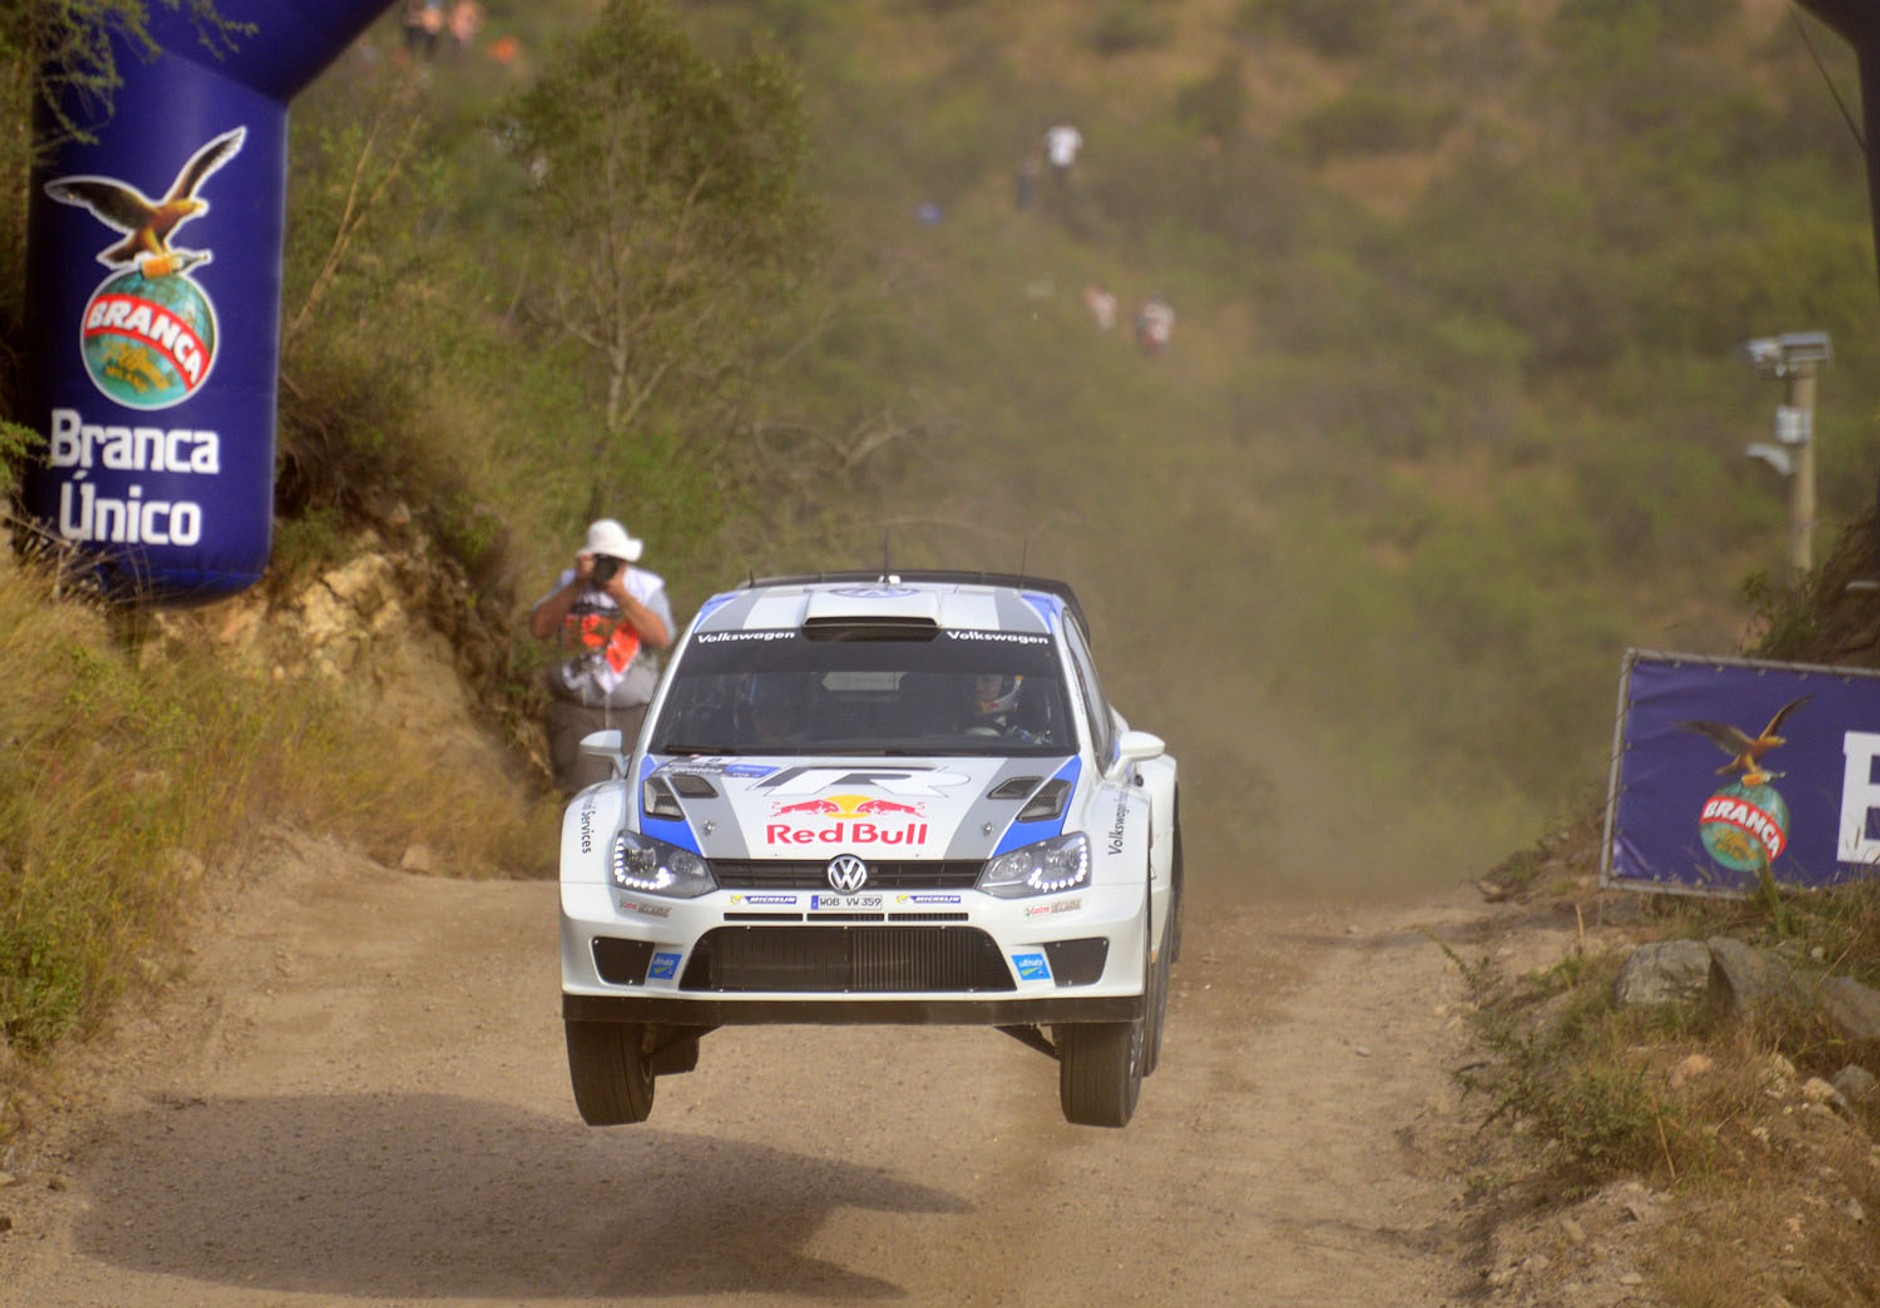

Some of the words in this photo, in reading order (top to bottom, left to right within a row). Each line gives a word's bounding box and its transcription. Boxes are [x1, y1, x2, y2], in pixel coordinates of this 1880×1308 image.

[86, 301, 201, 385] BRANCA
[51, 408, 220, 474] Branca
[60, 469, 201, 546] Único
[697, 631, 795, 643] Volkswagen
[946, 630, 1049, 645] Volkswagen
[581, 810, 596, 854] Services
[766, 822, 845, 845] Red
[851, 823, 928, 845] Bull
[1703, 800, 1780, 859] BRANCA
[819, 897, 840, 907] WOB
[846, 897, 860, 907] VW
[861, 897, 882, 907] 359
